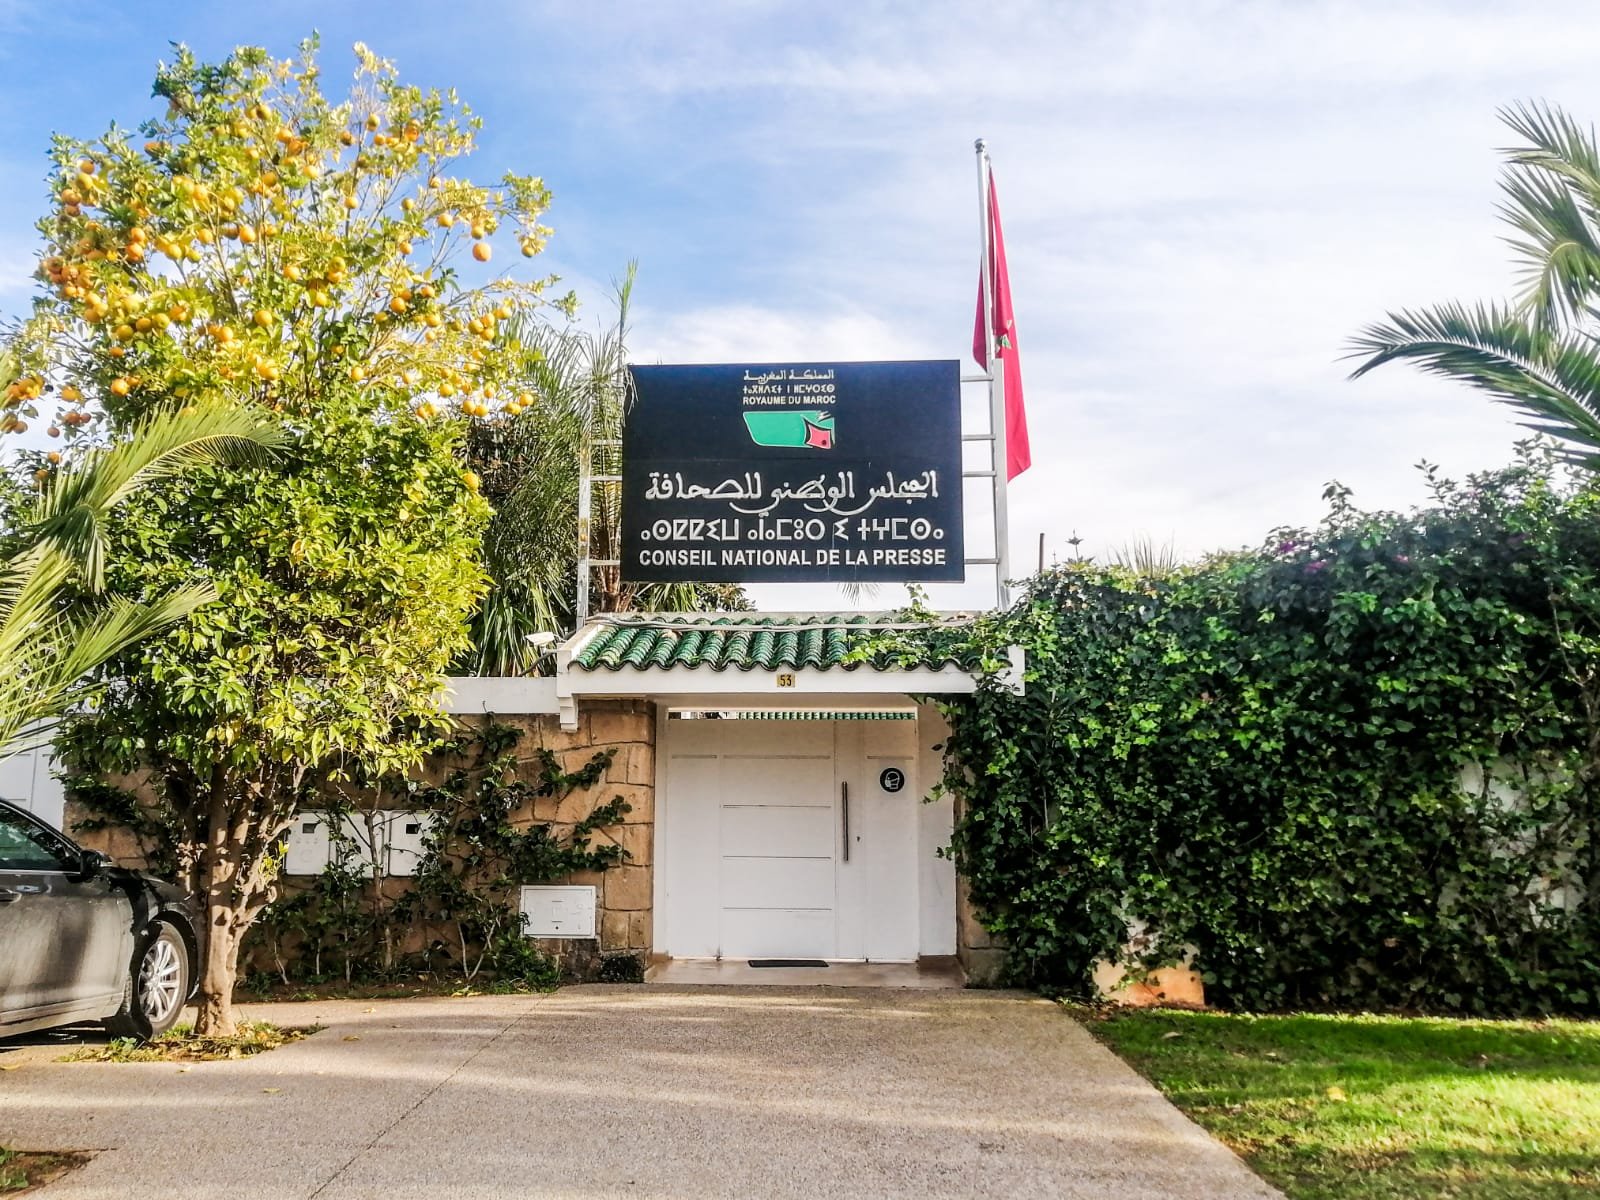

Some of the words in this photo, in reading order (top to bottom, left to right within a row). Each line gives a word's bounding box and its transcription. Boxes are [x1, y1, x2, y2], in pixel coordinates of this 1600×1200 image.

[743, 396, 786, 405] ROYAUME
[788, 396, 801, 404] DU
[803, 395, 836, 404] MAROC
[645, 471, 762, 500] للصحافة
[729, 470, 855, 517] الوطني
[823, 470, 939, 516] المجلس
[639, 549, 717, 566] CONSEIL
[721, 549, 812, 566] NATIONAL
[816, 549, 840, 566] DE
[845, 549, 869, 566] LA
[873, 548, 946, 566] PRESSE
[780, 674, 792, 687] 53
